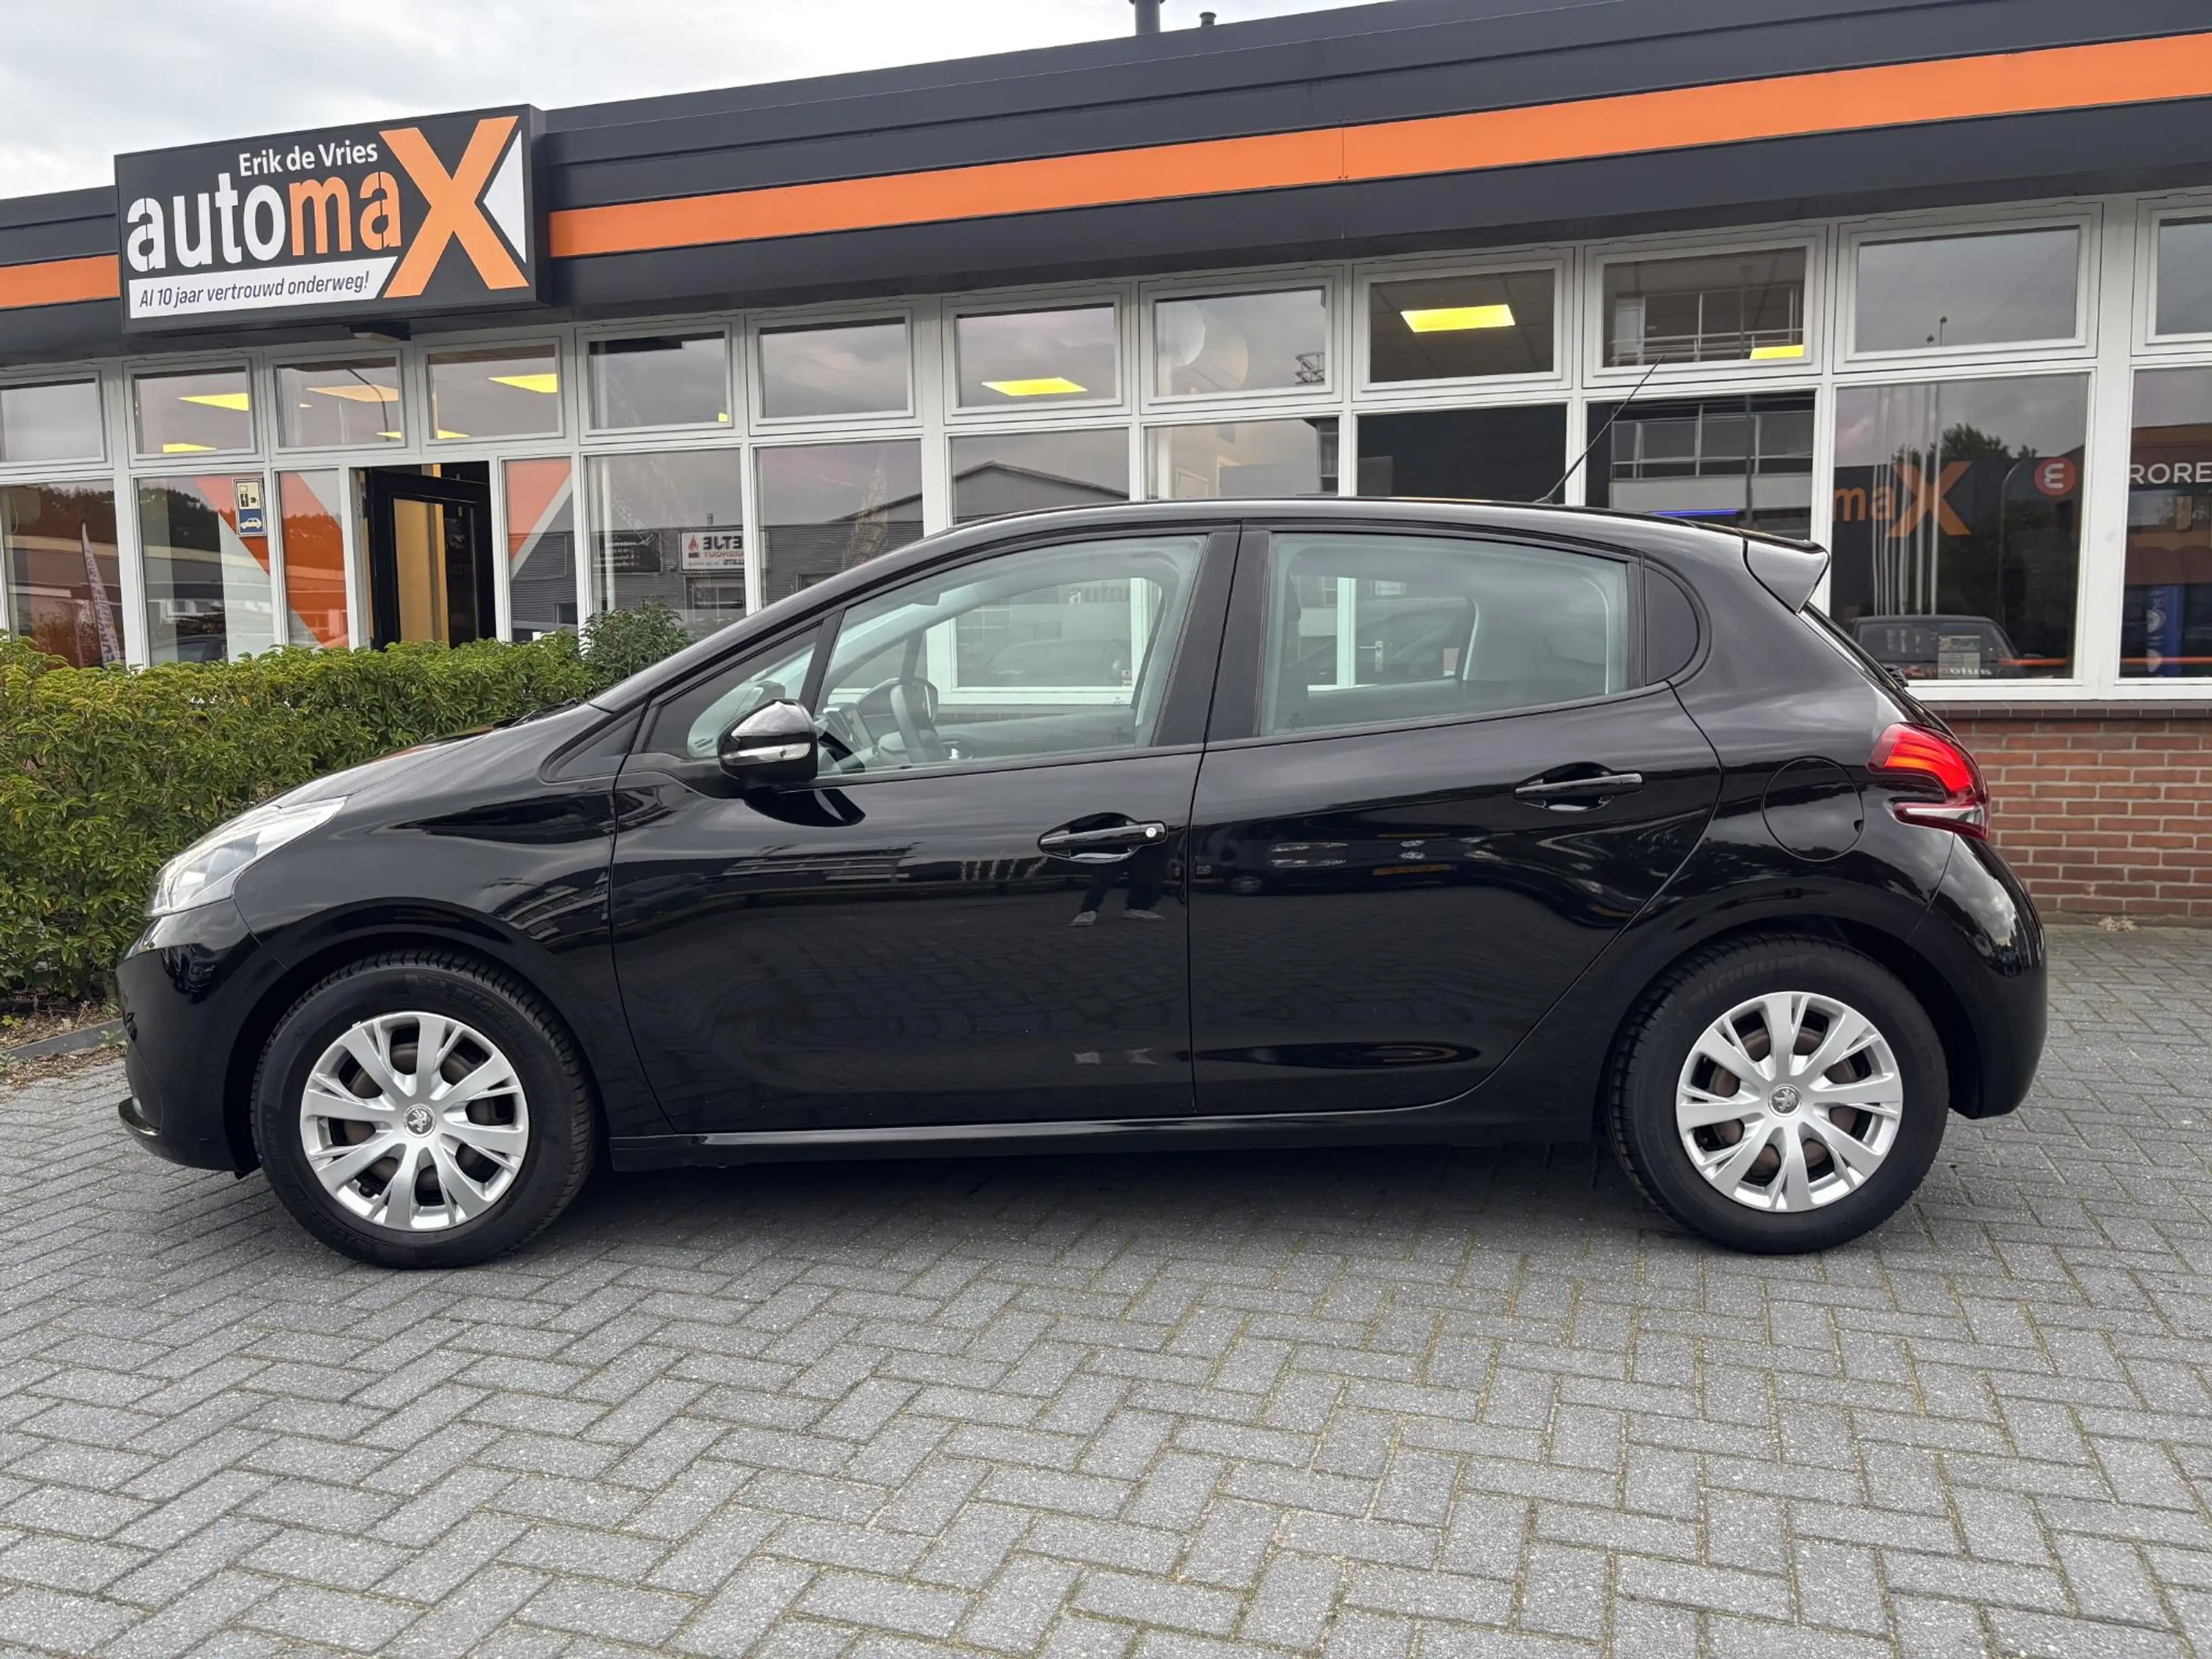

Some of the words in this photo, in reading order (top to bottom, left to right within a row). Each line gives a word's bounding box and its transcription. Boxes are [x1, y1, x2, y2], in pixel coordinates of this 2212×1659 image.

[238, 149, 283, 177] Erik
[286, 146, 315, 171] de
[318, 140, 378, 169] Vries
[139, 291, 154, 308] Al
[157, 290, 172, 306] 10
[173, 286, 204, 309] jaar
[207, 278, 284, 301] vertrouwd
[288, 271, 369, 296] onderweg!
